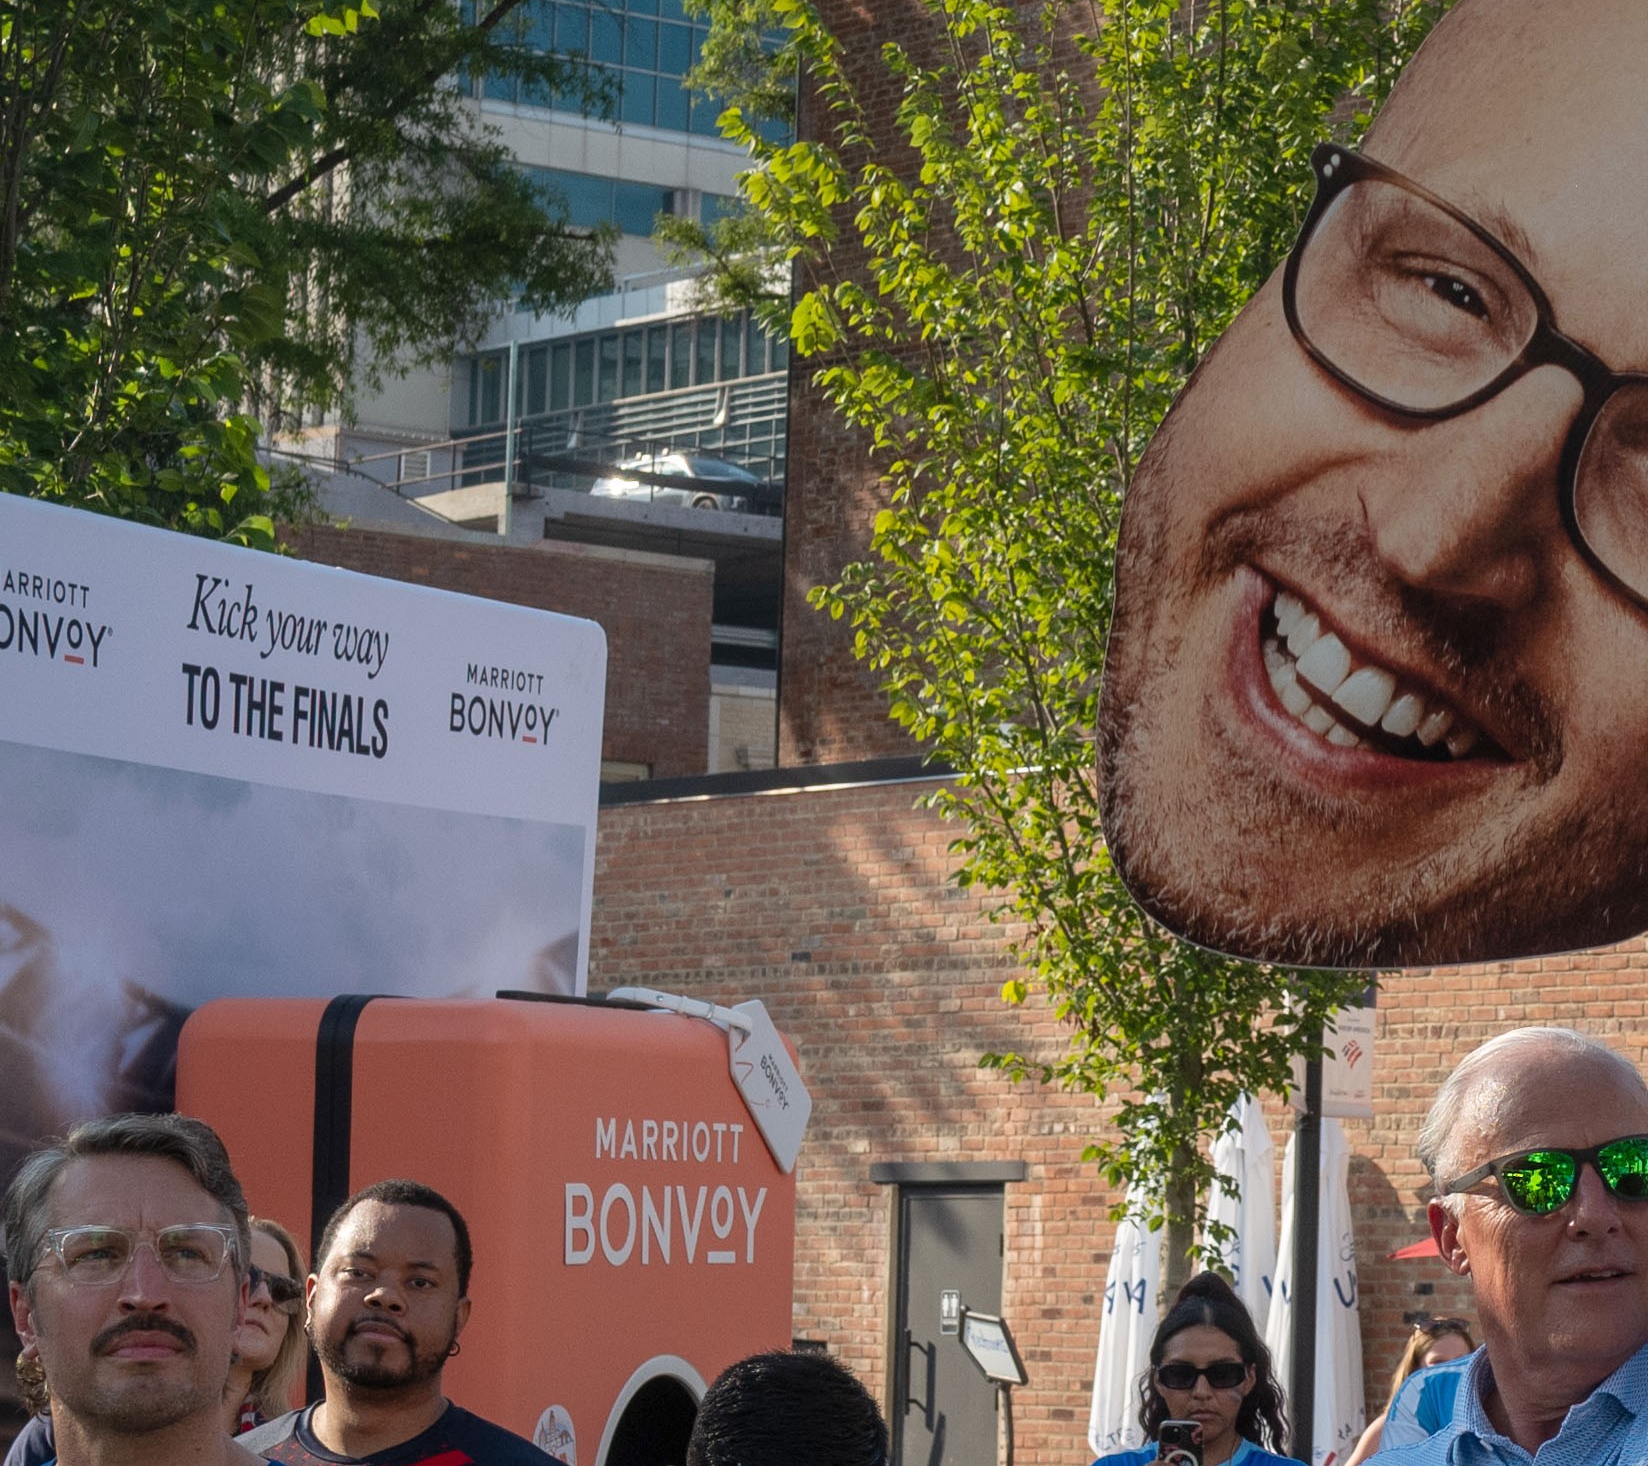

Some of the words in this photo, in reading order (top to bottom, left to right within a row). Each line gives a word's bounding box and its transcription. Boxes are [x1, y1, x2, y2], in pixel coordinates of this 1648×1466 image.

[188, 574, 258, 642] Kick
[261, 611, 329, 658] your
[332, 625, 390, 678] way
[182, 663, 220, 730] TO
[229, 672, 284, 741] THE
[293, 688, 389, 758] FINALS
[467, 663, 543, 695] MARRIOTT
[450, 692, 555, 745] BONVOY
[596, 1118, 743, 1163] MARRIOTT
[565, 1183, 768, 1265] BONVOY
